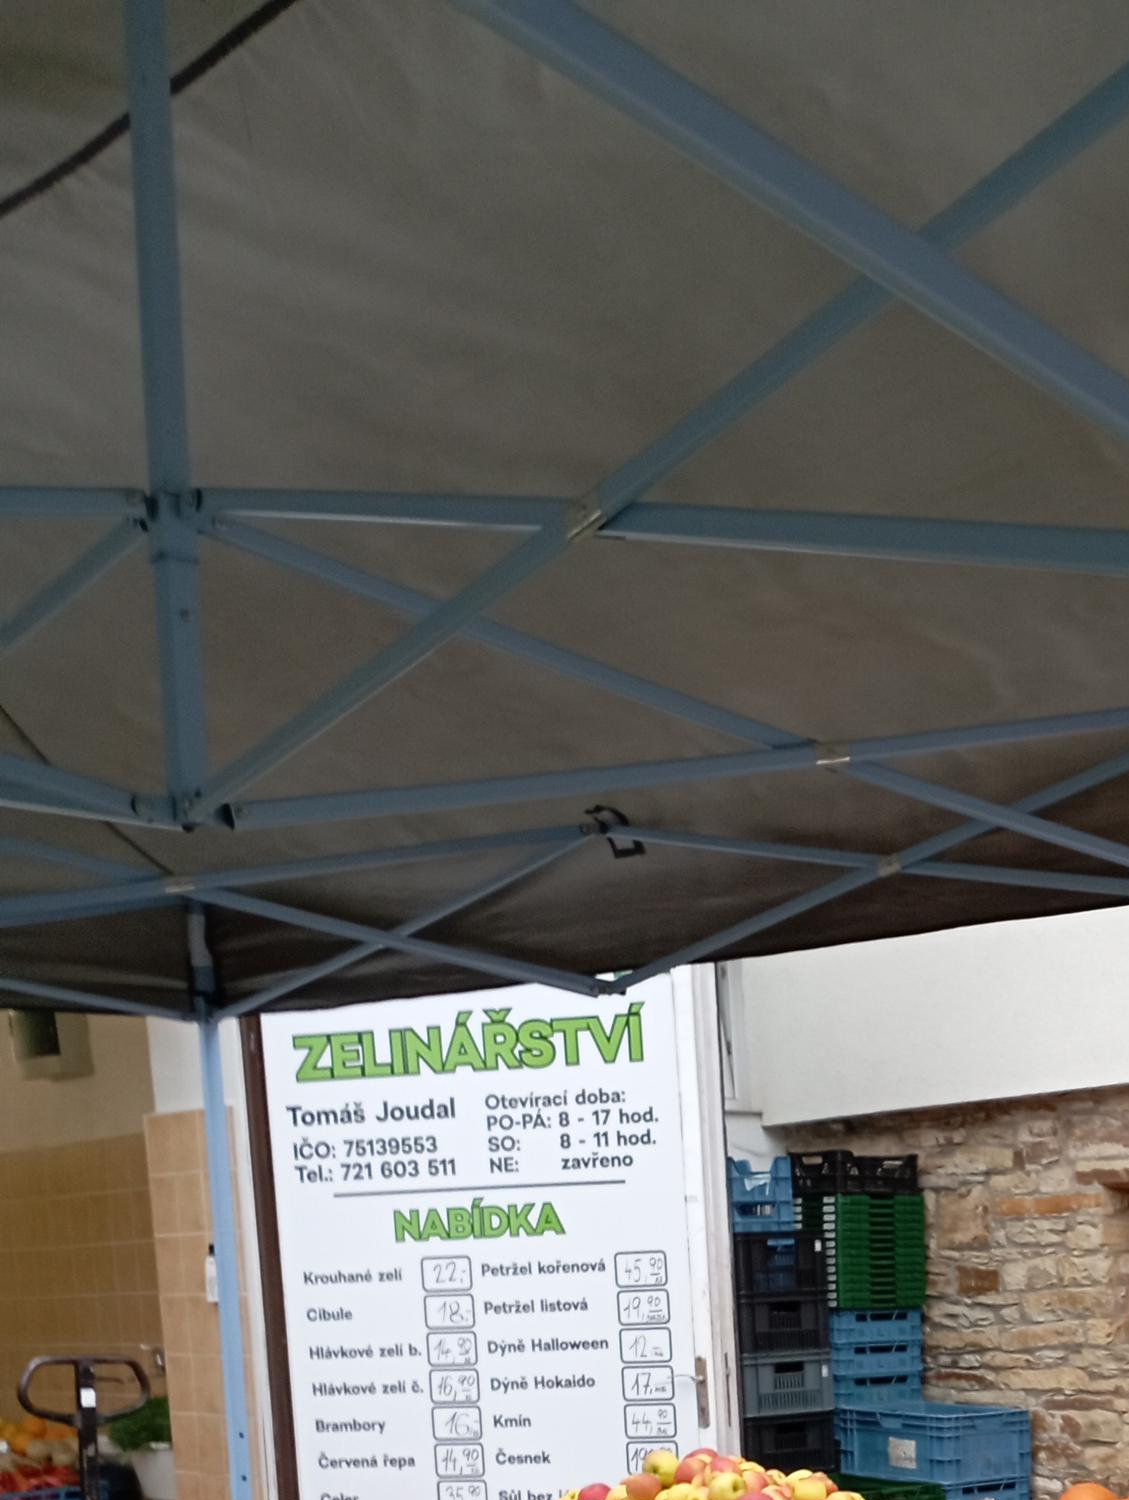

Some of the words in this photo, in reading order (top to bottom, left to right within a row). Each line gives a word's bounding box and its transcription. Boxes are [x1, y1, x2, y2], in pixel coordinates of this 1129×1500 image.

[292, 1001, 645, 1083] ZELINÁŘSTVÍ
[485, 1090, 568, 1110] Otevírací
[575, 1088, 625, 1105] doba:
[286, 1102, 366, 1127] Tomáš
[375, 1097, 456, 1122] Joudal
[486, 1109, 551, 1131] PO-PÁ:
[558, 1111, 570, 1128] 8
[592, 1109, 611, 1126] 17
[619, 1106, 659, 1124] hod.
[293, 1137, 336, 1160] IČO:
[343, 1135, 437, 1158] 75139553
[488, 1136, 520, 1152] SO:
[560, 1132, 571, 1149] 8
[593, 1131, 609, 1148] 11
[617, 1129, 656, 1147] hod.
[294, 1165, 333, 1184] Tel.:
[340, 1163, 373, 1181] 721
[380, 1160, 419, 1178] 603
[427, 1158, 456, 1176] 511
[489, 1157, 519, 1173] NE:
[561, 1152, 633, 1170] zavřeno
[393, 1197, 566, 1243] NABÍDKA
[303, 1269, 372, 1285] Krouhané
[378, 1268, 402, 1282] zelí
[481, 1261, 532, 1277] Petržel
[538, 1258, 606, 1275] kořenová
[306, 1308, 353, 1322] Cibule
[484, 1299, 535, 1315] Petržel
[540, 1297, 588, 1312] listová
[309, 1345, 374, 1360] Hlávkové
[379, 1344, 403, 1358] zelí
[409, 1343, 422, 1356] b.
[487, 1339, 525, 1356] Dýně
[531, 1338, 609, 1352] Halloween
[312, 1381, 376, 1396] Hlávkové
[382, 1380, 406, 1394] zelí
[412, 1380, 424, 1394] č.
[490, 1376, 528, 1394] Dýně
[534, 1375, 595, 1390] Hokaido
[315, 1418, 385, 1435] Brambory
[493, 1414, 531, 1428] Kmín
[318, 1452, 378, 1469] Červená
[383, 1453, 416, 1471] řepa
[496, 1448, 551, 1465] Česnek
